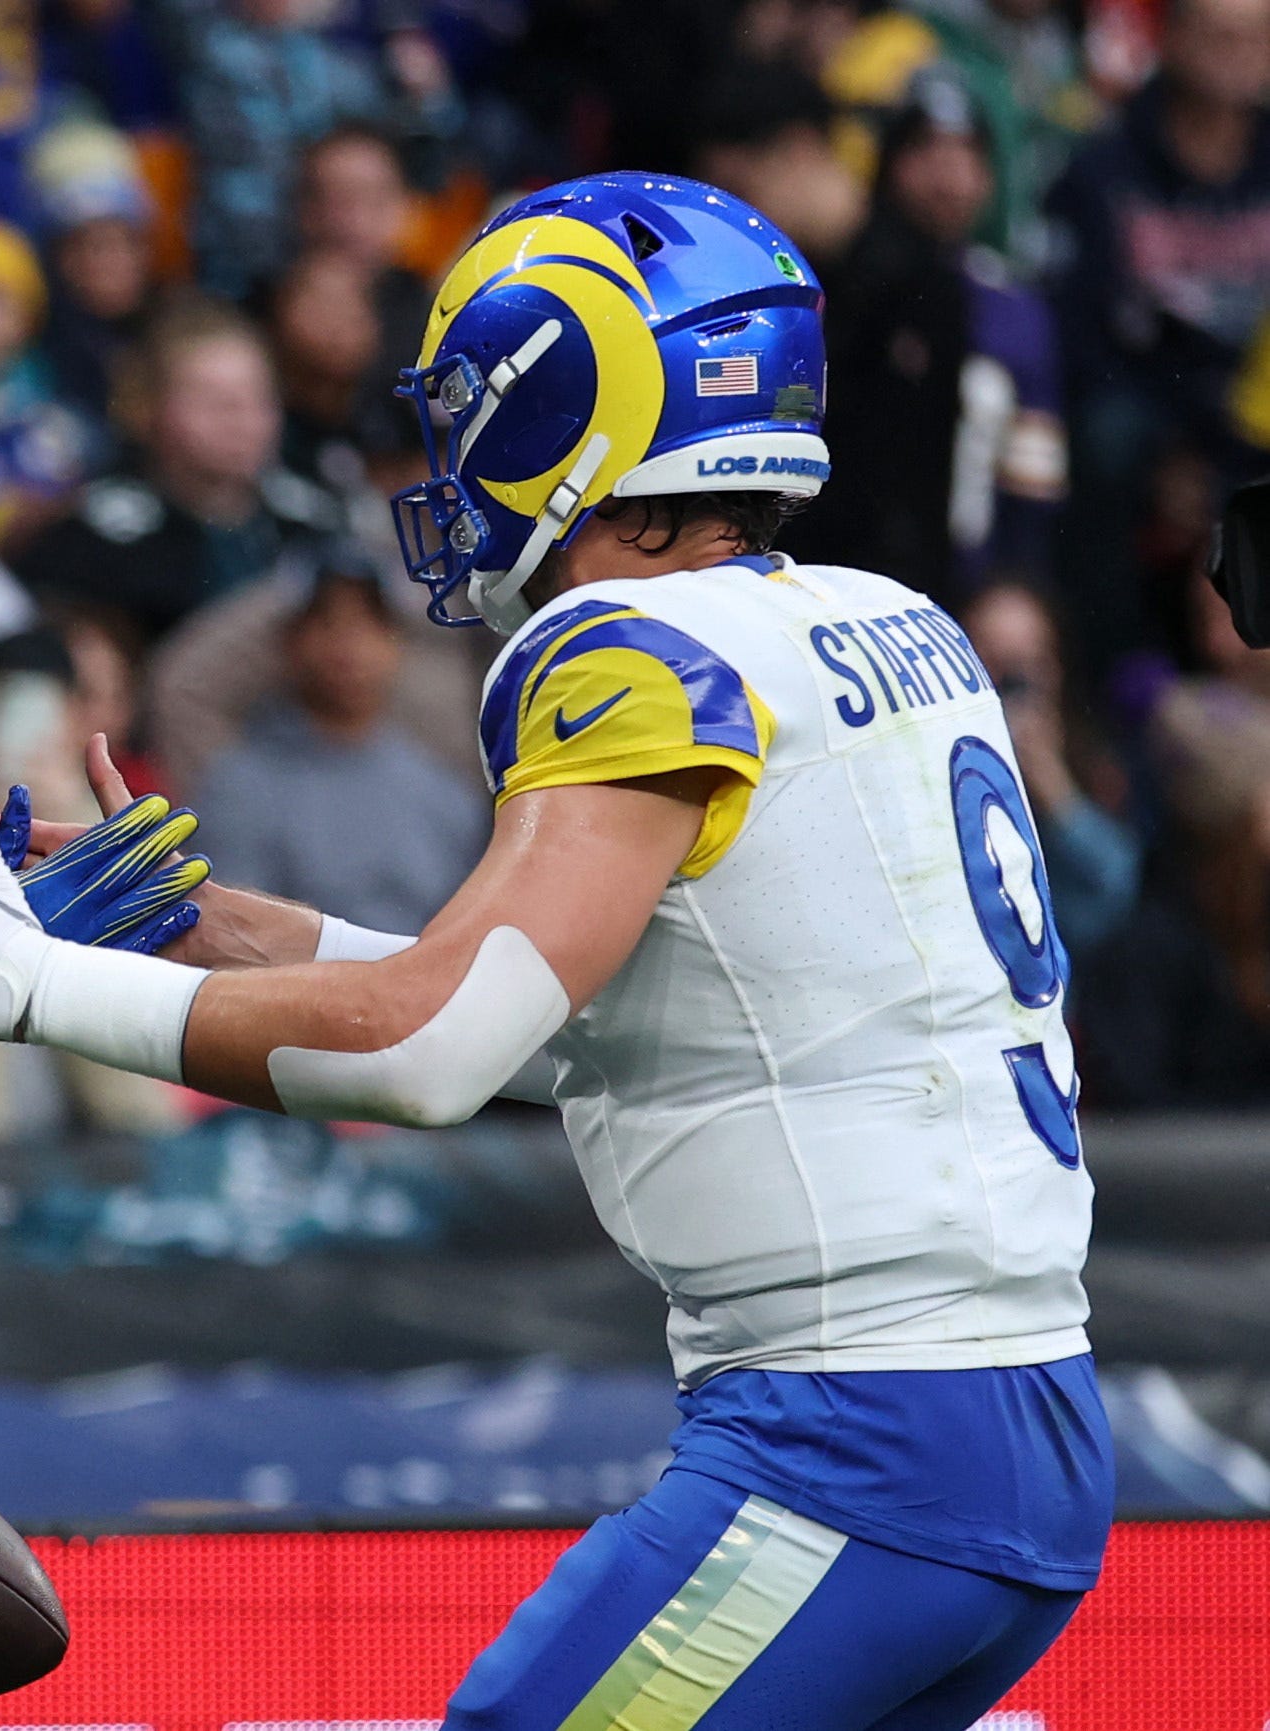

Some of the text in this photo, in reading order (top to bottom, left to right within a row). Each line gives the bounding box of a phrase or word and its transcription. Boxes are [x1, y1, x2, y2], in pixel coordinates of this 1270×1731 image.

[698, 456, 758, 476] LOS
[810, 604, 995, 728] STAFFOR
[950, 735, 1080, 1171] 9
